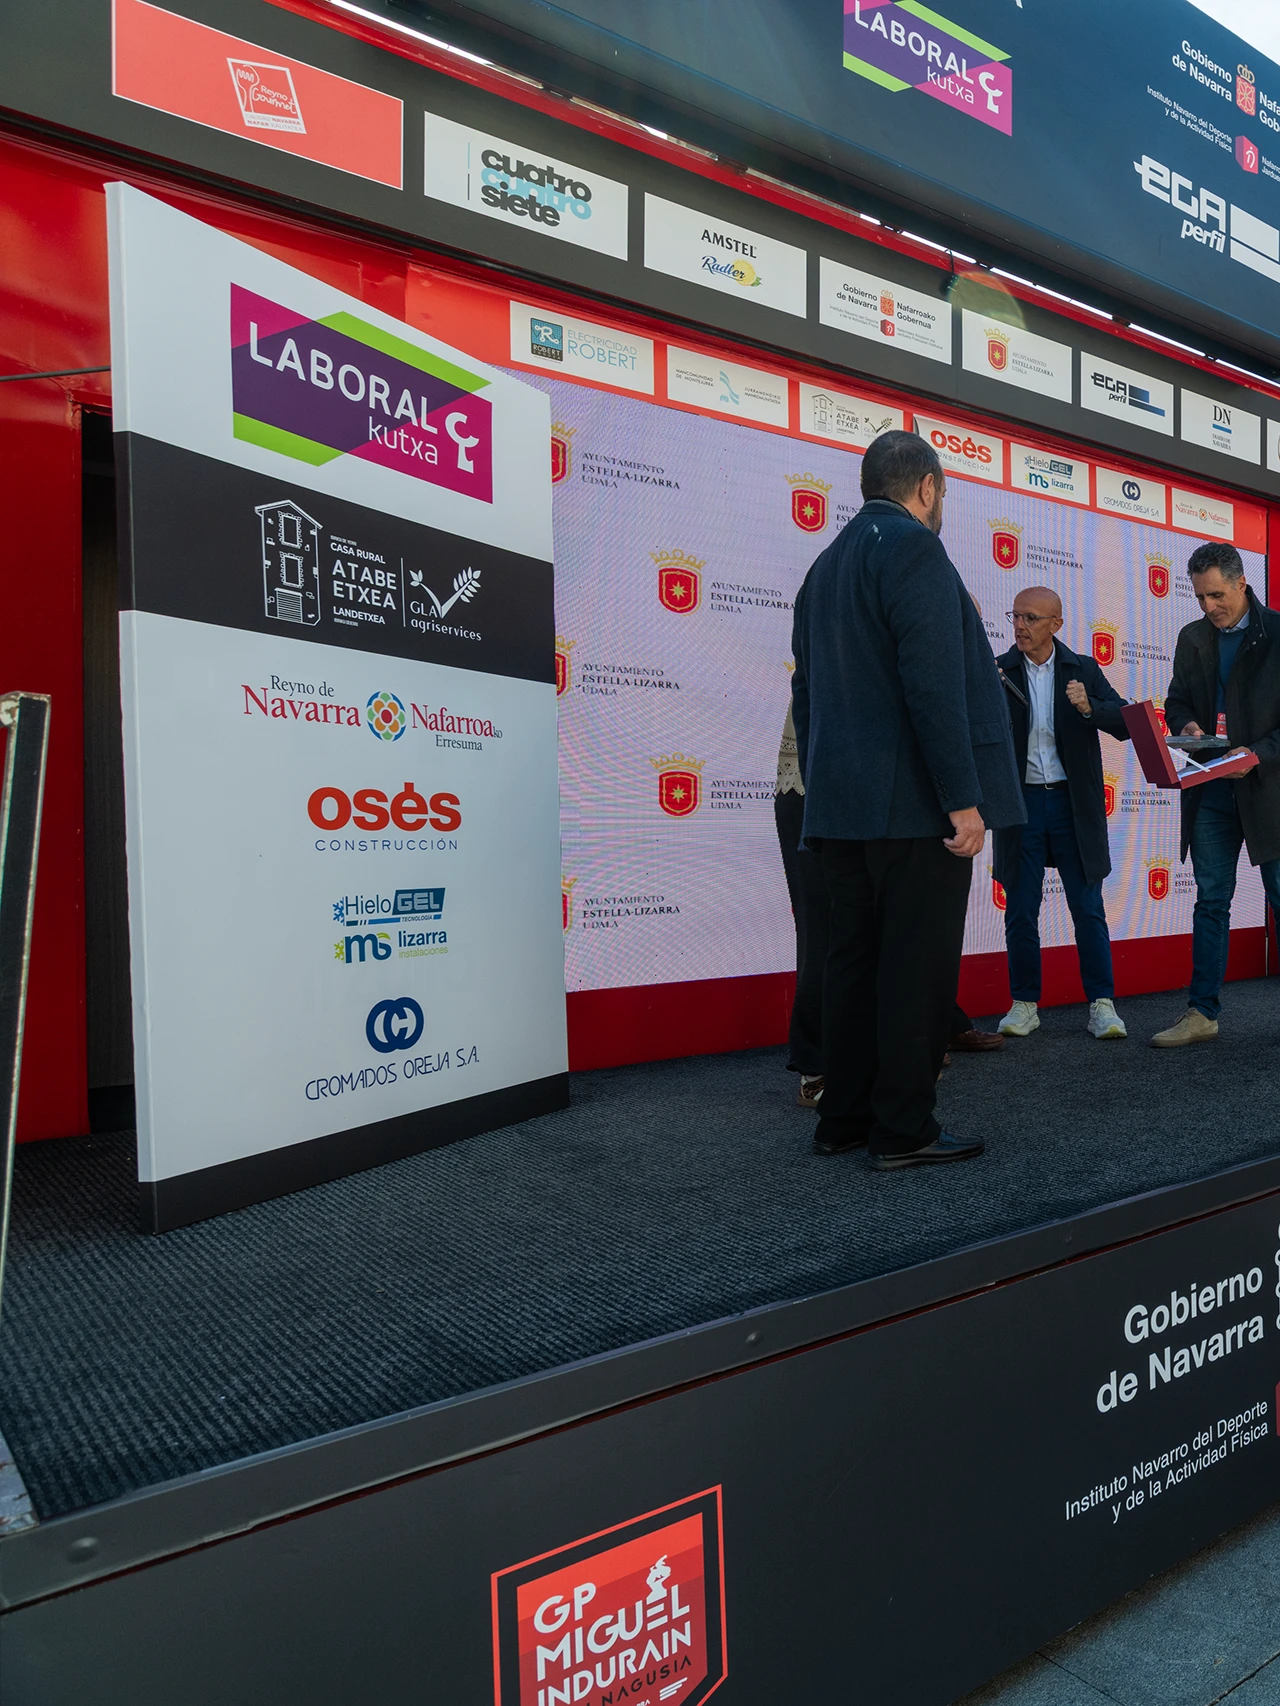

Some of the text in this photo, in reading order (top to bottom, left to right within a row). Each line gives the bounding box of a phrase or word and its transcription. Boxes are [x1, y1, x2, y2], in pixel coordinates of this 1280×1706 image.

[854, 0, 974, 85] LABORAL
[1181, 40, 1233, 83] Gobierno
[926, 66, 974, 104] kutxa
[1172, 54, 1233, 102] de Navarra
[252, 87, 298, 115] Gourmet
[260, 84, 288, 102] Reyno
[1147, 85, 1233, 144] Instituto Navarro del Deporte
[1171, 111, 1214, 143] de Actividad
[481, 149, 592, 203] cuatro
[481, 180, 561, 228] siete
[701, 228, 757, 259] AMSTEL
[1180, 219, 1226, 254] perfil
[700, 255, 746, 283] Radler
[836, 291, 878, 312] de Navarra
[842, 283, 878, 302] Gobierno
[896, 302, 936, 322] Nafarroako
[896, 311, 932, 330] Gobernua
[533, 345, 561, 356] ROBERT
[567, 329, 637, 356] ELECTRICIDAD
[567, 339, 637, 371] ROBERT
[249, 321, 438, 435] LABORAL
[1011, 365, 1029, 376] UDALA
[1108, 392, 1128, 404] perfil
[836, 412, 860, 424] ATABE
[836, 420, 860, 431] ETXEA
[1212, 404, 1232, 426] DN
[368, 416, 438, 466] kutxa
[582, 452, 665, 475] AYUNTAMIENTO
[1029, 455, 1071, 475] Hielo GEL
[581, 475, 618, 489] UDALA
[582, 463, 680, 490] ESTELLA-LIZARRA
[1052, 478, 1074, 491] lizarra
[330, 542, 386, 564] CASA RURAL
[332, 559, 397, 590] ATABE
[333, 580, 397, 610] ETXEA
[710, 582, 782, 598] AYUNTAMIENTO
[710, 592, 795, 611] ESTELLA-LIZARRA
[333, 606, 386, 625] LANDETXEA
[710, 603, 742, 614] UDALA
[410, 616, 482, 642] agriservices
[582, 663, 665, 677] AYUNTAMIENTO
[270, 674, 335, 698] Reyno de
[582, 675, 680, 690] ESTELLA-LIZARRA
[582, 685, 618, 696] UDALA
[241, 684, 362, 728] Navarra
[435, 734, 483, 751] Erresuma
[711, 801, 742, 809] UDALA
[315, 837, 459, 852] CONSTRUCCIÓN
[344, 890, 441, 916] Hielo GEL
[583, 895, 665, 906] AYUNTAMIENTO
[583, 905, 681, 918] ESTELLA-LIZARRA
[401, 914, 433, 923] TECNOLOGÍA
[583, 920, 619, 930] UDALA
[398, 930, 448, 948] lizarra
[398, 946, 448, 959] instalaciones
[305, 1063, 397, 1100] CROMADOS
[403, 1051, 450, 1079] OREJA
[1124, 1266, 1263, 1344] Gobierno
[1096, 1314, 1264, 1414] de Navarra
[1064, 1399, 1268, 1520] Instituto Navarro del Deporte
[1110, 1420, 1269, 1524] y de la Actividad Física
[533, 1582, 597, 1635] GP
[536, 1584, 690, 1682] MIGUEL
[537, 1620, 692, 1706] INDURAIN
[602, 1655, 692, 1706] NAGUSIA
